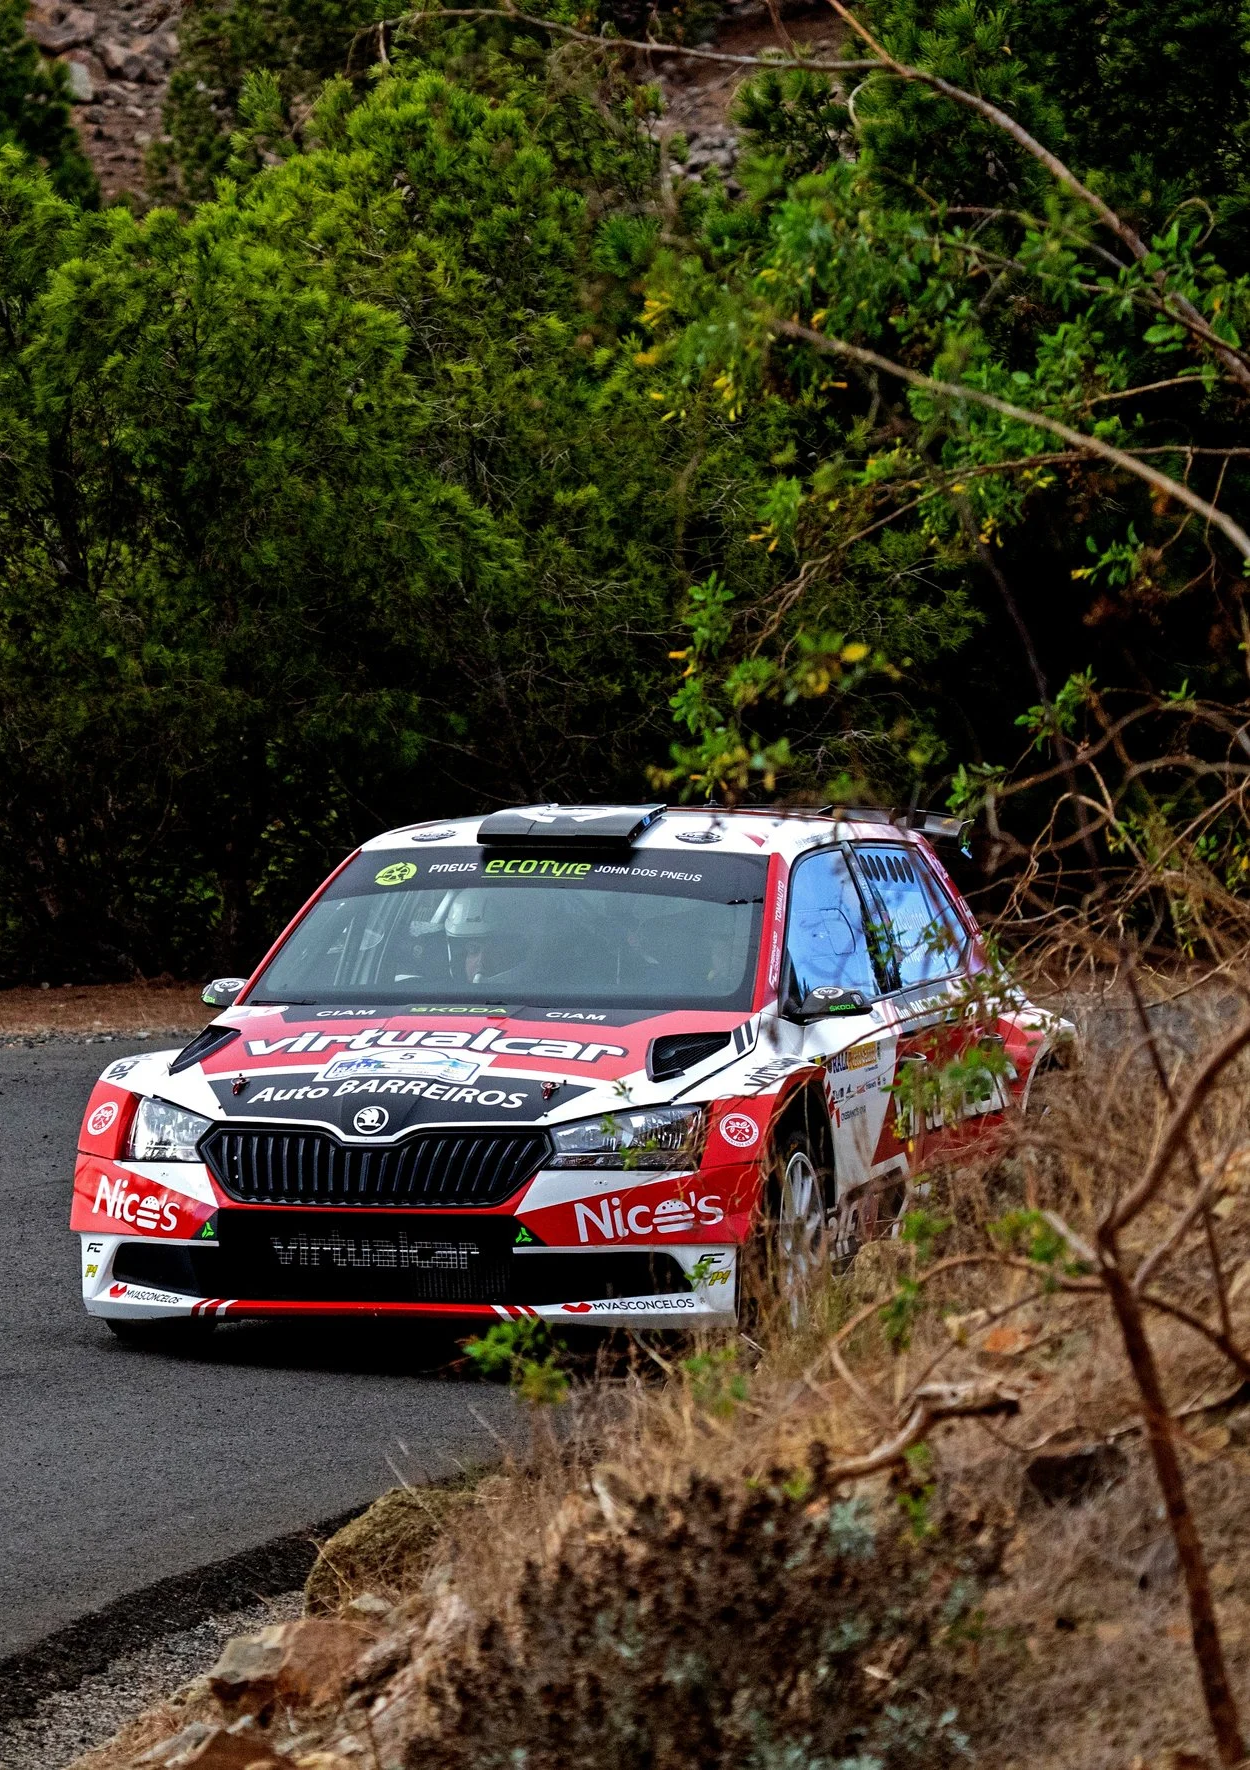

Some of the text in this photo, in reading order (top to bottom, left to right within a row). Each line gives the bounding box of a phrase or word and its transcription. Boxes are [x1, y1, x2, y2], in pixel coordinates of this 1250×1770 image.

[428, 861, 479, 874] PNEUS
[594, 864, 630, 876] JOHN
[630, 867, 659, 878] DOS
[660, 869, 703, 882] PNEUS
[315, 1009, 376, 1018] CIAM
[545, 1012, 607, 1021] CIAM
[246, 1026, 627, 1062] virtualcar
[246, 1079, 529, 1109] Auto BARREIROS
[269, 1230, 480, 1269] virtualcar
[125, 1289, 183, 1305] MVASCONCELOS
[591, 1298, 695, 1311] MVASCONCELOS
